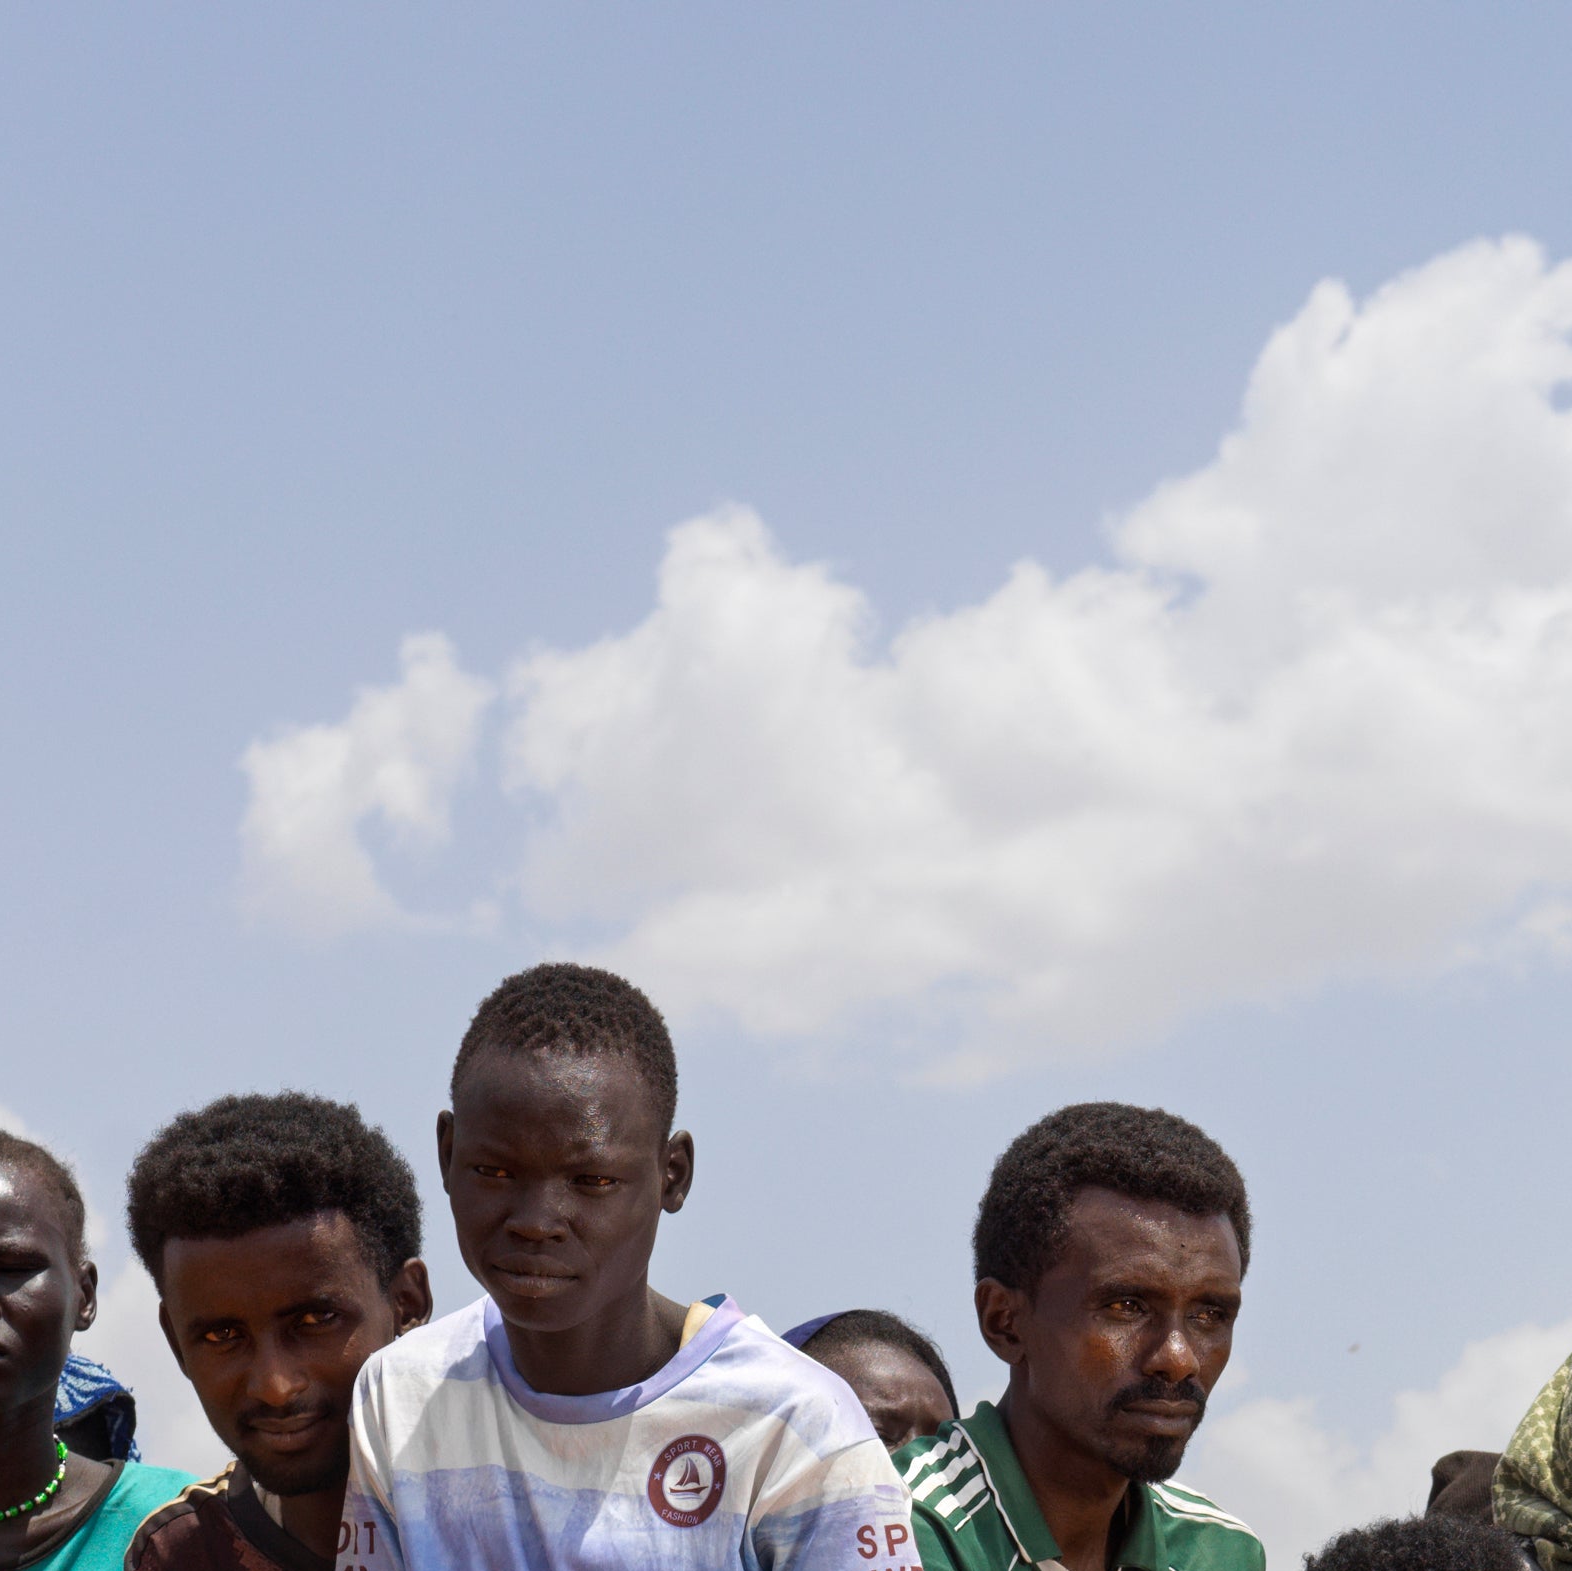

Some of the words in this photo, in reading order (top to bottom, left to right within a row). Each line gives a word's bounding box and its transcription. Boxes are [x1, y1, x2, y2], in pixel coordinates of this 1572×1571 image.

[664, 1440, 698, 1462] SPORT
[703, 1443, 722, 1468] WEAR
[661, 1508, 699, 1524] FASHION
